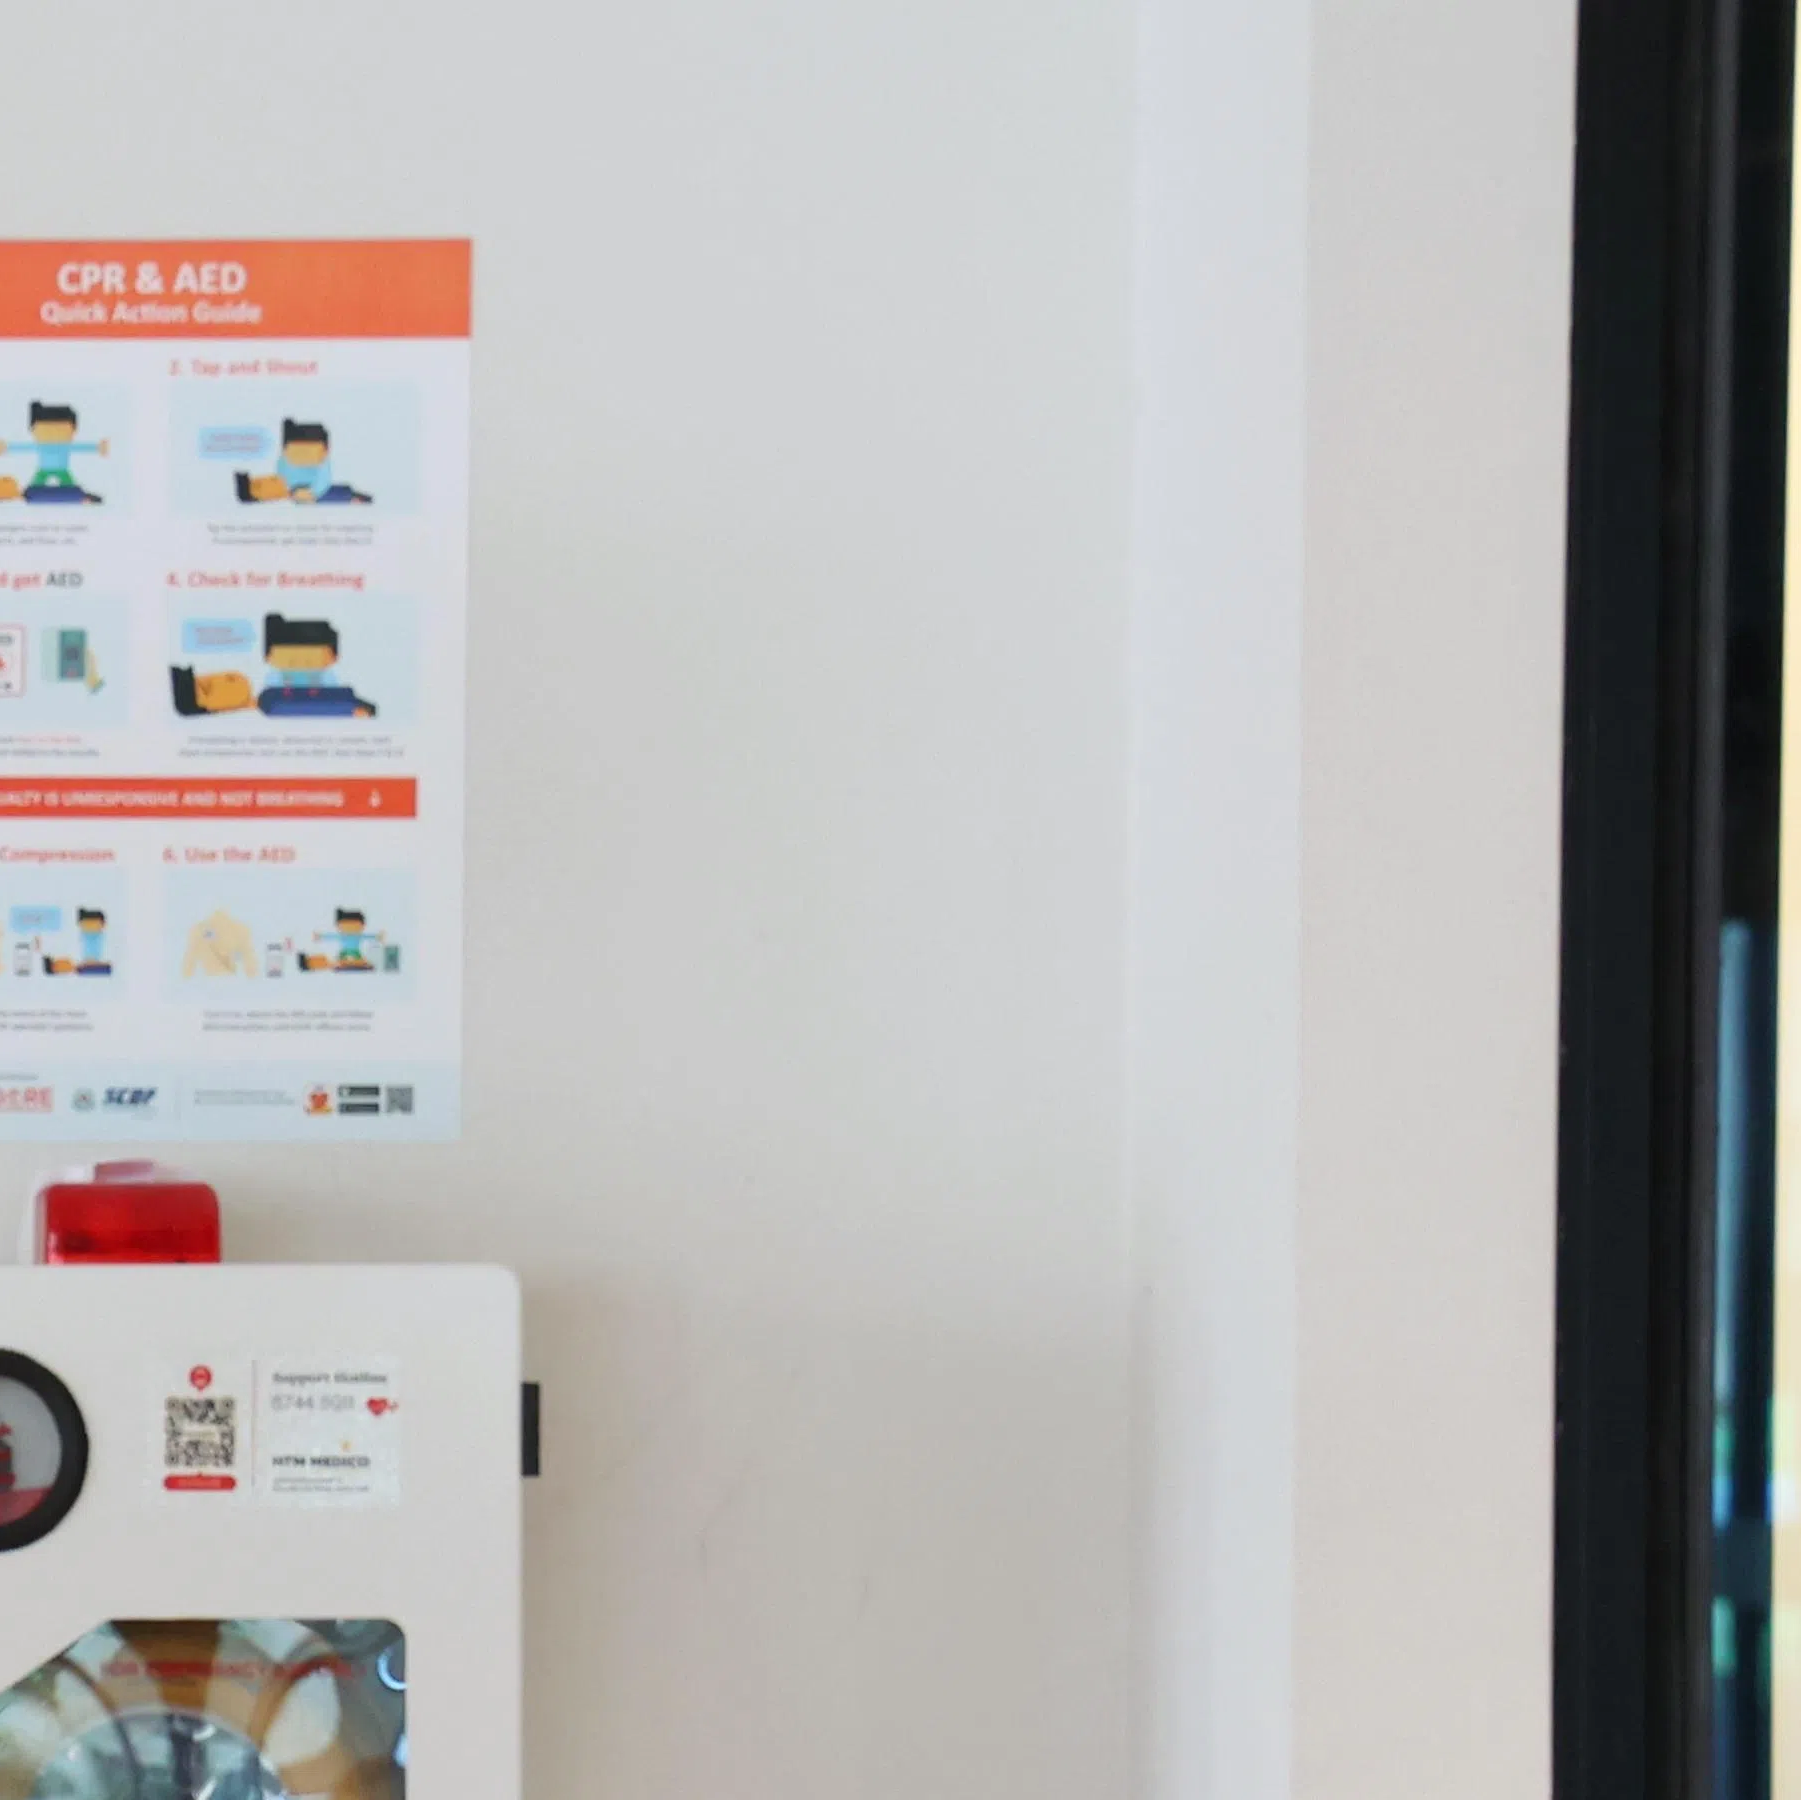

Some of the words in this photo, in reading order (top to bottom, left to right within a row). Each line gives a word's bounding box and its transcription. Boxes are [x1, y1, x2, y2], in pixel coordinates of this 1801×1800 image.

[56, 262, 126, 295] CPR
[136, 261, 165, 294] &
[172, 262, 247, 294] AED
[40, 301, 107, 324] Quick
[112, 301, 189, 323] Action
[192, 301, 262, 323] Guide
[191, 361, 223, 377] Tap
[228, 360, 260, 375] and
[266, 360, 317, 375] Shout
[13, 573, 42, 590] get
[46, 572, 84, 587] AED
[187, 572, 239, 588] Check
[246, 572, 271, 587] for
[277, 572, 365, 590] Breathing
[0, 845, 116, 863] Compression
[184, 847, 217, 862] Use
[223, 847, 252, 862] the
[258, 847, 296, 862] AED
